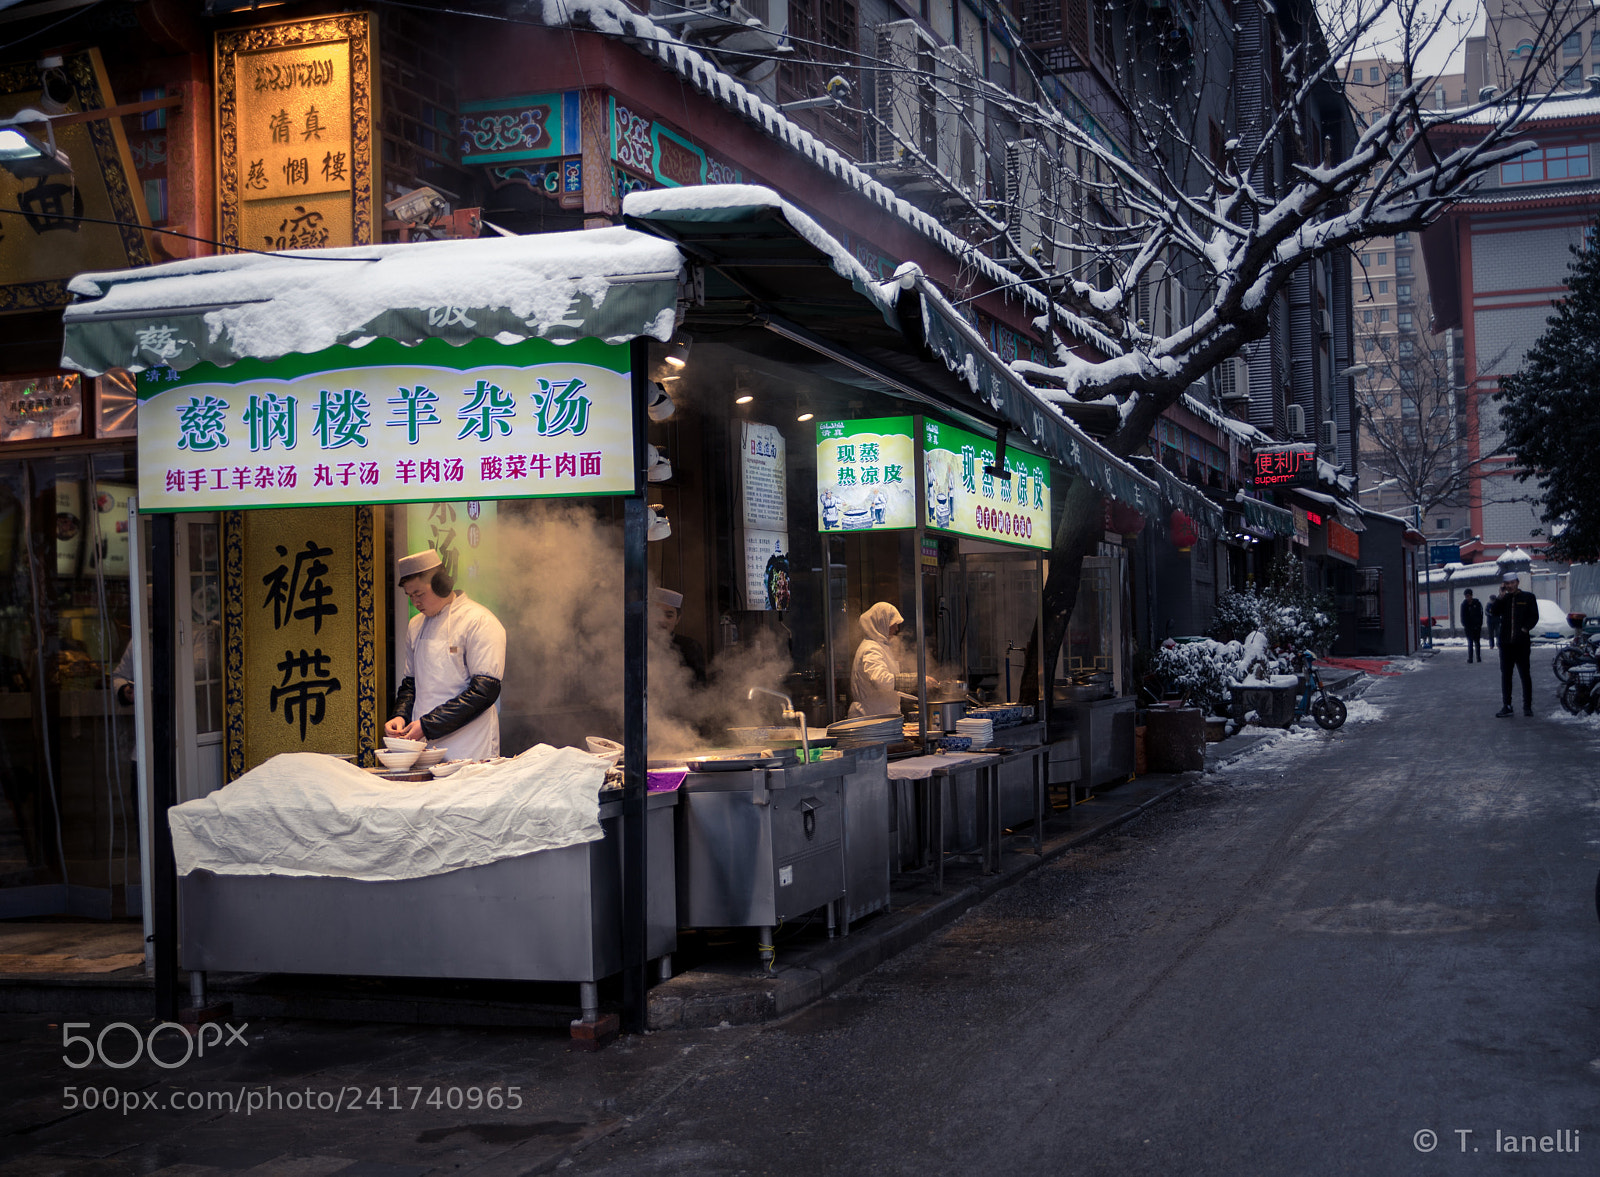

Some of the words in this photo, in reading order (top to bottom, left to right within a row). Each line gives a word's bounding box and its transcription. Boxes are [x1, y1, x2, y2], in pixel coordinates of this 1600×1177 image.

[269, 105, 326, 143] 清真
[145, 368, 181, 382] 清真
[175, 377, 593, 452] 慈悯楼羊杂汤
[836, 442, 880, 464] 现蒸
[165, 464, 298, 492] 纯手工羊杂汤
[313, 461, 380, 488] 丸子汤
[395, 457, 464, 484] 羊肉汤
[480, 451, 602, 481] 酸菜牛肉面
[837, 463, 904, 487] 热凉皮
